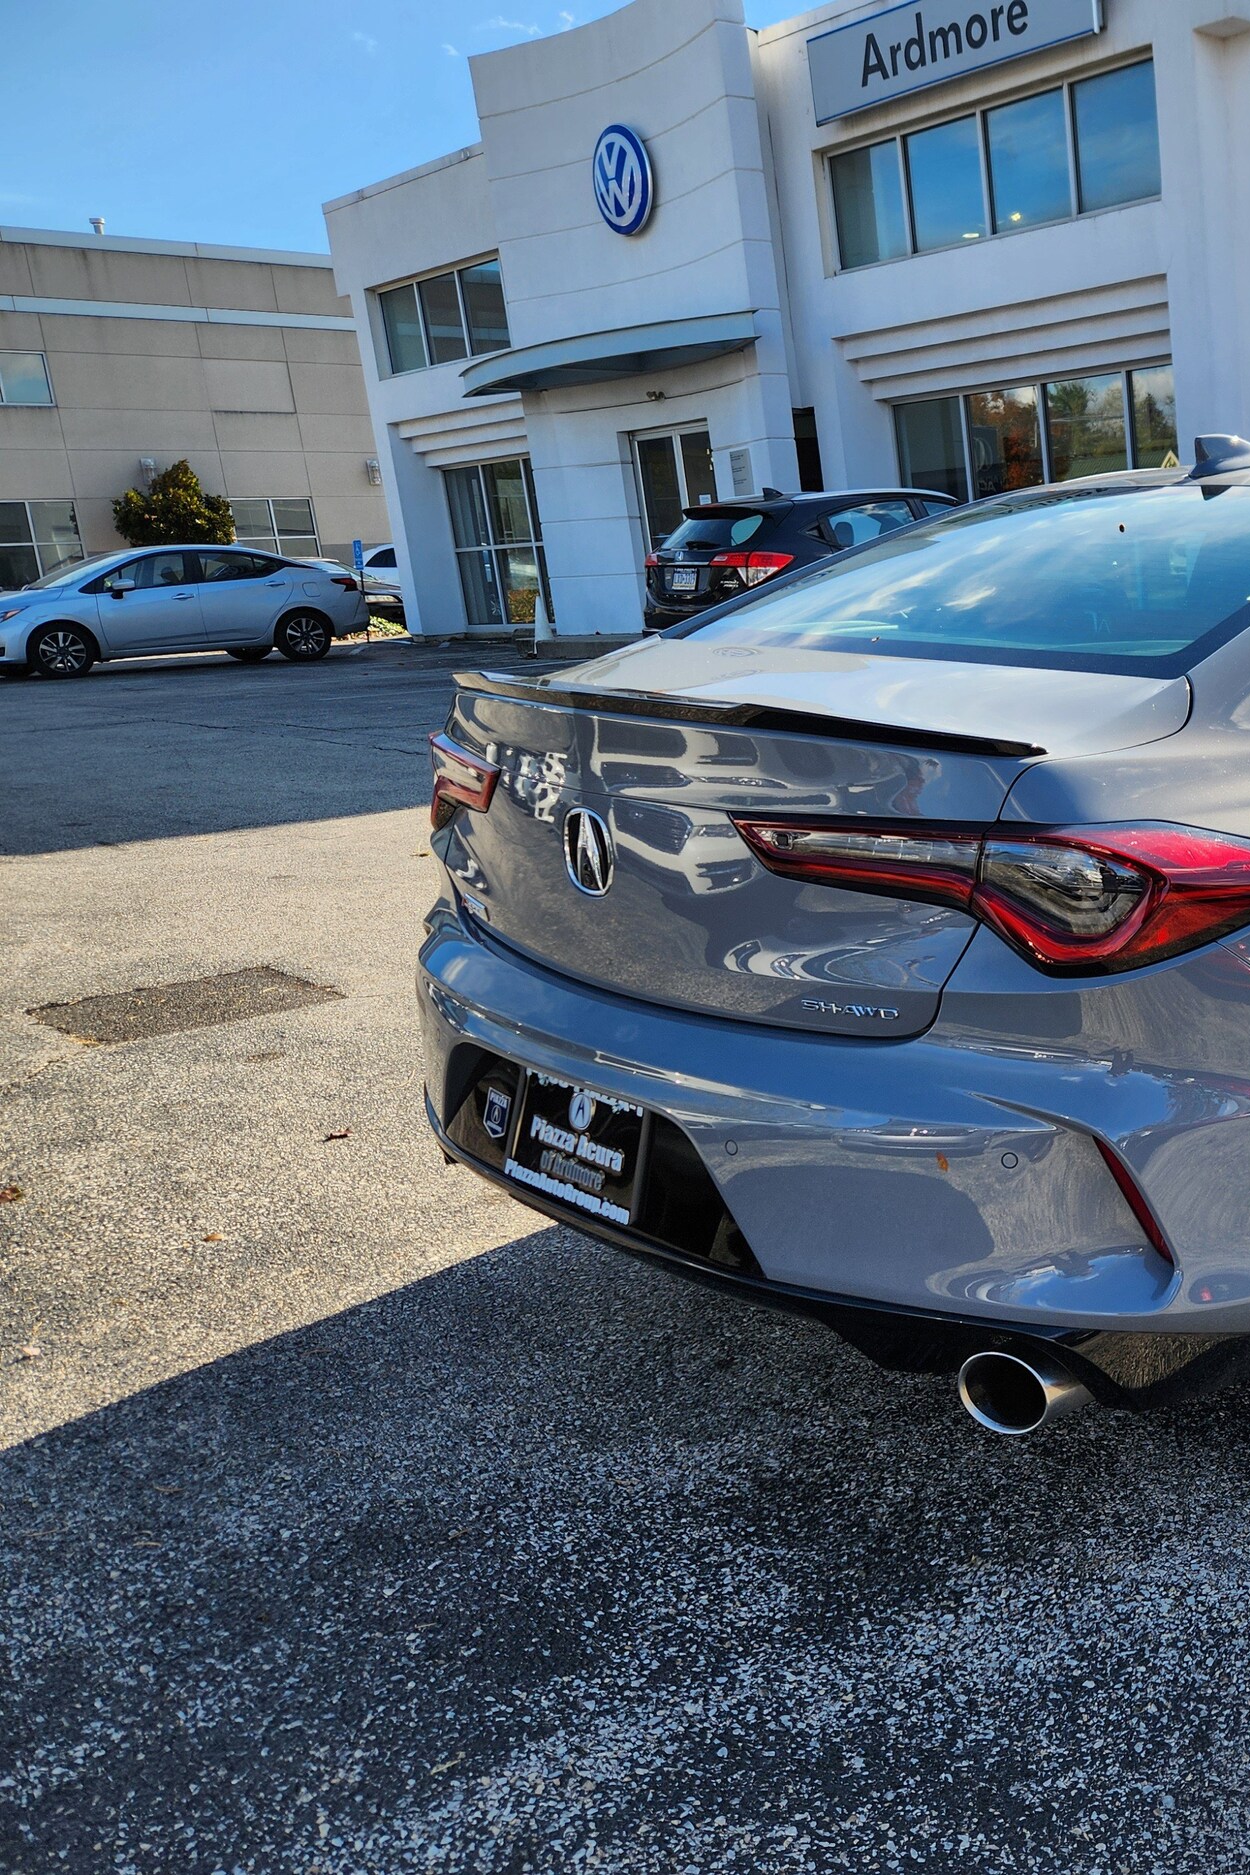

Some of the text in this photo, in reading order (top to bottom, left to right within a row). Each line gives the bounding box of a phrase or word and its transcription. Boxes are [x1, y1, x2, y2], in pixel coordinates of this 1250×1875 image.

[861, 0, 1028, 88] Ardmore
[595, 129, 647, 230] VW
[801, 999, 899, 1020] SH-AWD
[530, 1114, 621, 1172] Piazza Acura
